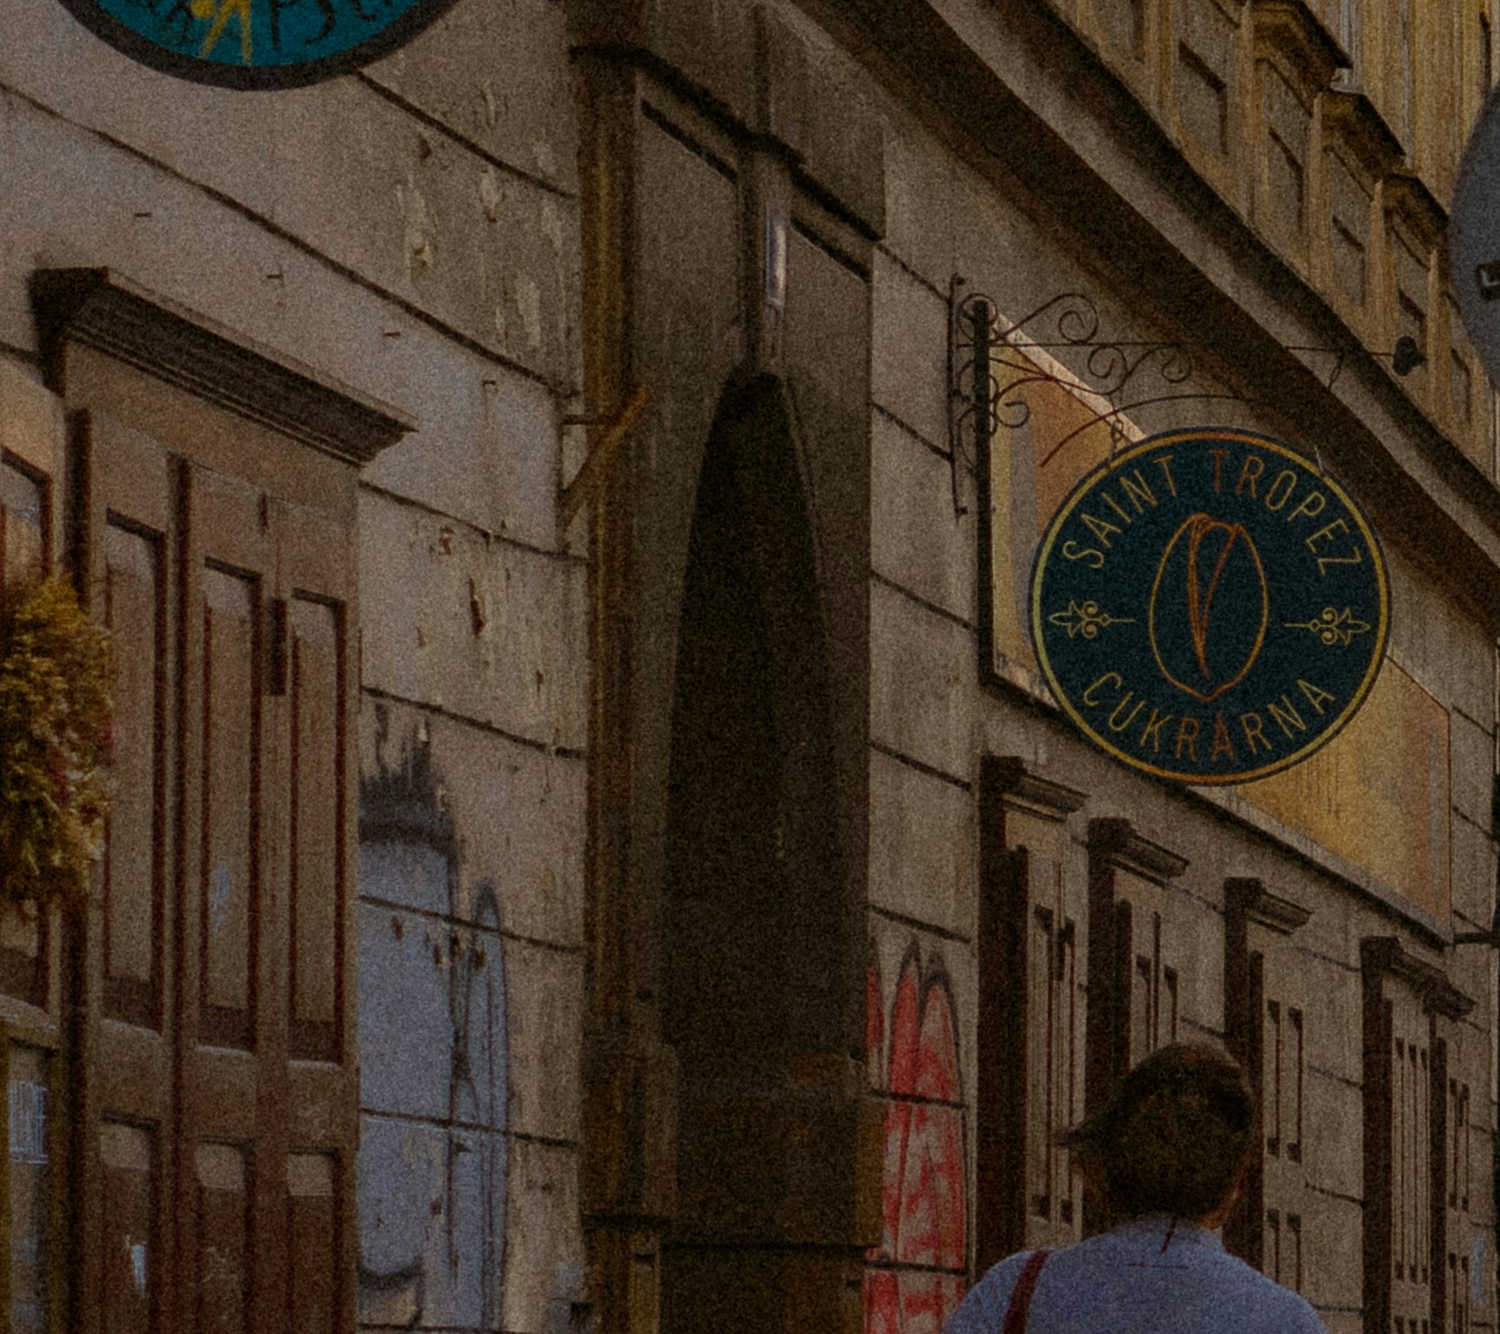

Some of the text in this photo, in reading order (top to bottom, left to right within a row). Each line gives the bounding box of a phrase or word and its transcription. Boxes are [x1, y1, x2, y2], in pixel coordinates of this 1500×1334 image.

[1061, 448, 1364, 578] SAINT TROPEZ
[1081, 669, 1339, 764] CUKRÁRNA
